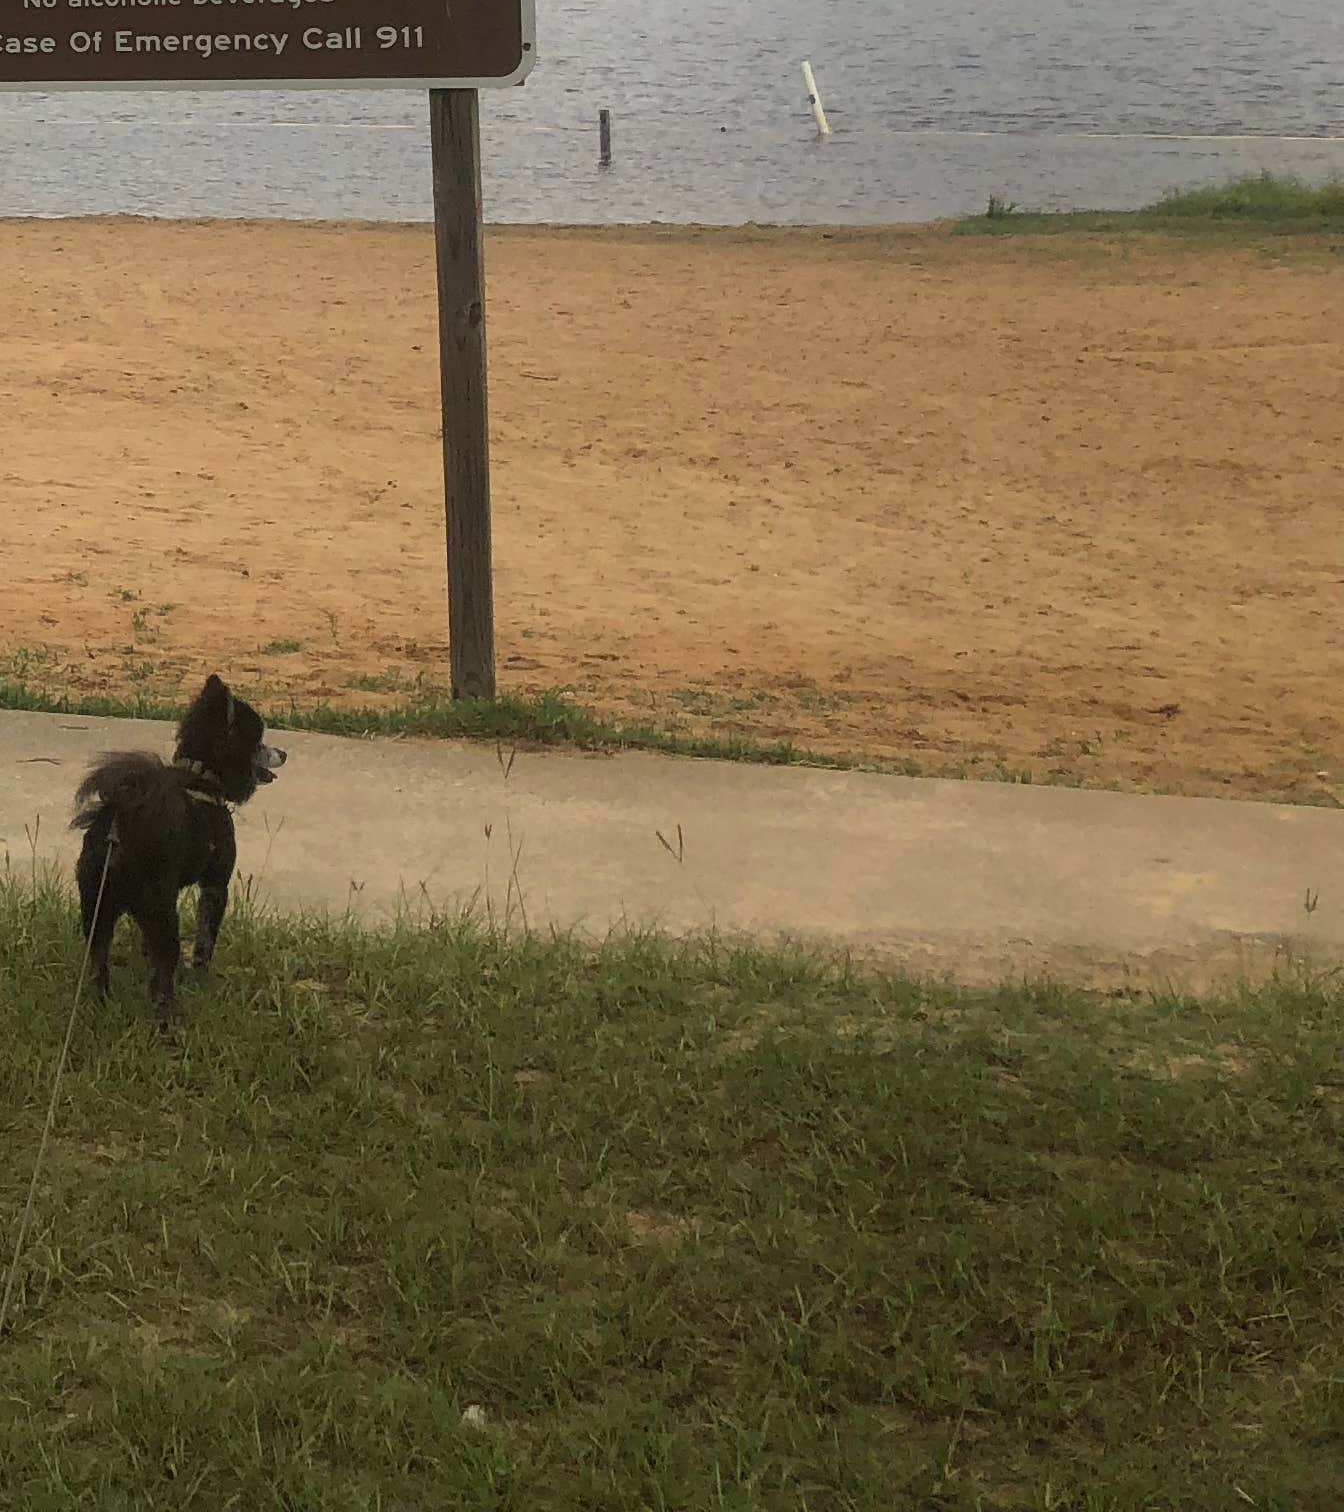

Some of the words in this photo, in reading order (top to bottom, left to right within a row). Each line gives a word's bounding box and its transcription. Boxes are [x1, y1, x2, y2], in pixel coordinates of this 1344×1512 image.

[69, 30, 102, 53] Of
[115, 30, 289, 58] Emergency
[302, 26, 361, 50] Call
[375, 25, 423, 49] 911
